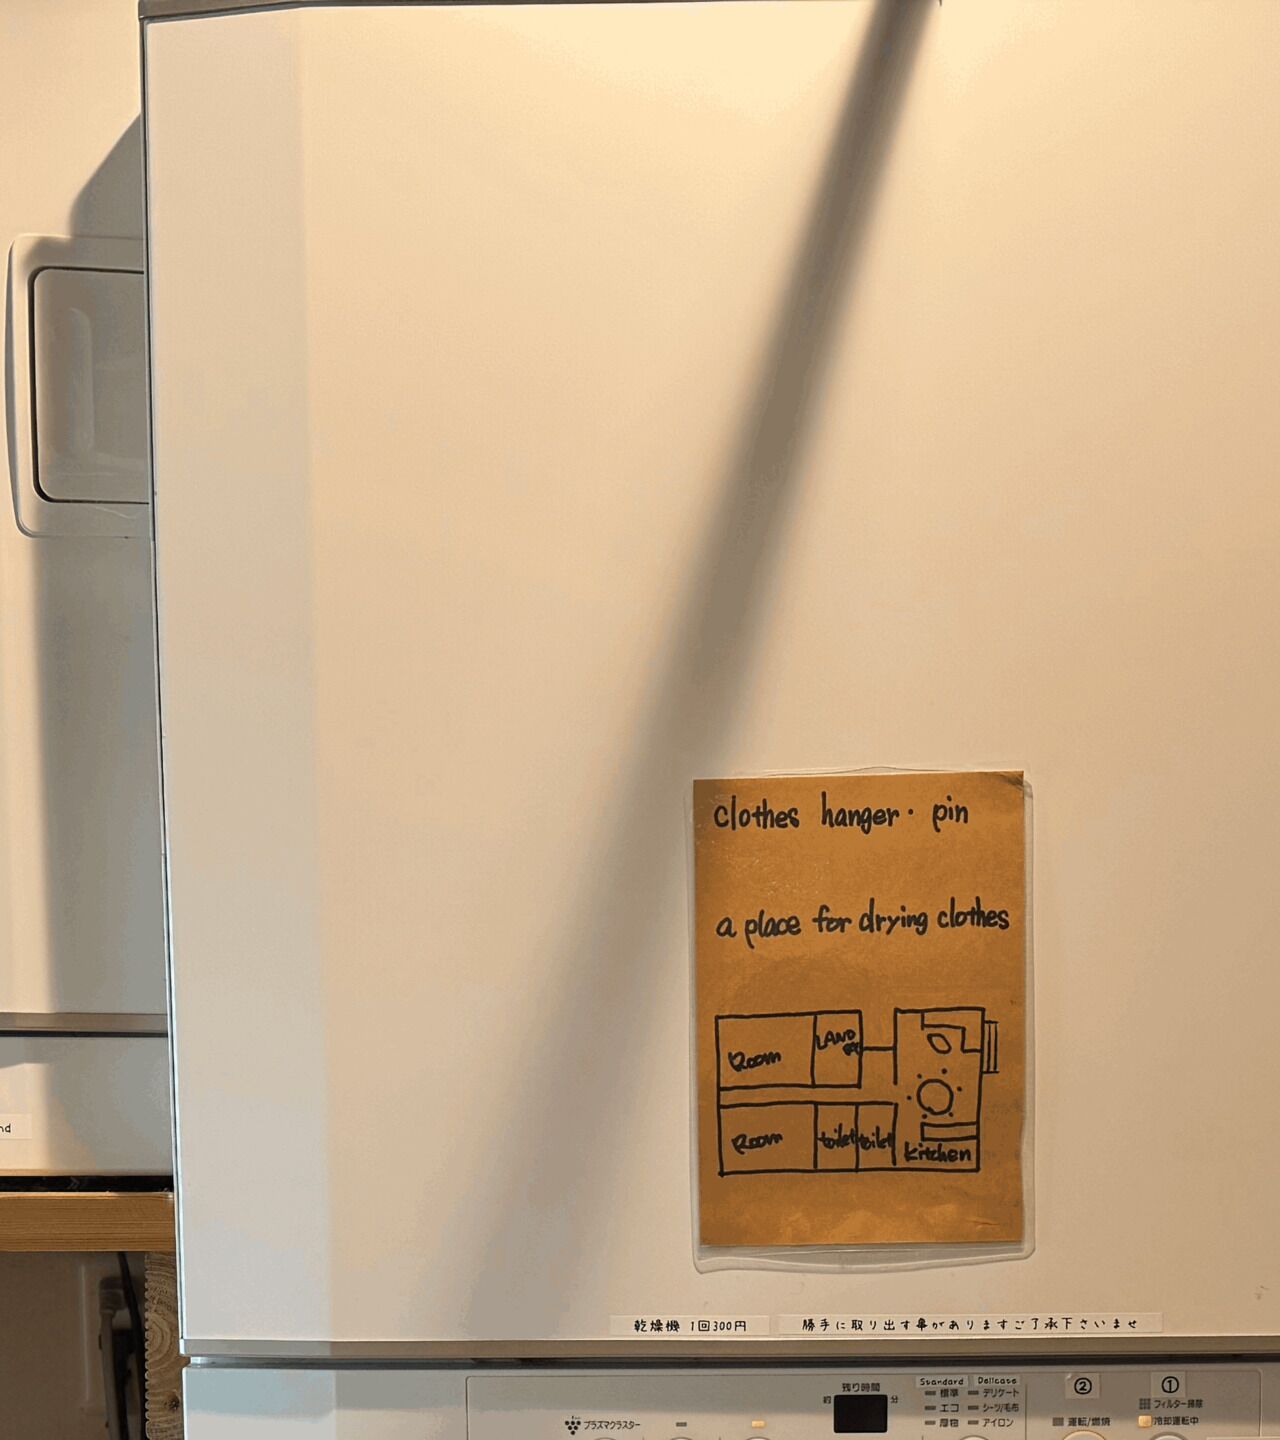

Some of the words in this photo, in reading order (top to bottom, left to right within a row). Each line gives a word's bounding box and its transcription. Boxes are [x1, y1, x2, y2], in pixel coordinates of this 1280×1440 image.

[713, 795, 800, 831] clothes
[821, 791, 901, 834] hanger
[932, 795, 969, 832] pin
[716, 916, 738, 937] a
[744, 909, 802, 949] place
[812, 904, 852, 933] for
[858, 897, 929, 935] drying
[936, 896, 1010, 930] clothes
[728, 1051, 781, 1072] Room
[817, 1123, 857, 1149] toilet
[731, 1132, 783, 1155] Room
[904, 1141, 971, 1163] kitchen
[634, 1318, 681, 1333] 乾燥機
[690, 1319, 747, 1332] 1回300円
[919, 1377, 964, 1387] Standard
[977, 1376, 1017, 1386] Delicate
[842, 1382, 880, 1393] 残り時間
[940, 1388, 959, 1398] 標準
[982, 1387, 1020, 1398] デリケート
[940, 1403, 959, 1412] エコ
[982, 1403, 1019, 1413] シーツ/毛布
[583, 1420, 641, 1430] プラズマクラスター
[982, 1418, 1014, 1427] アイロン
[1153, 1416, 1199, 1426] 冷却運転中
